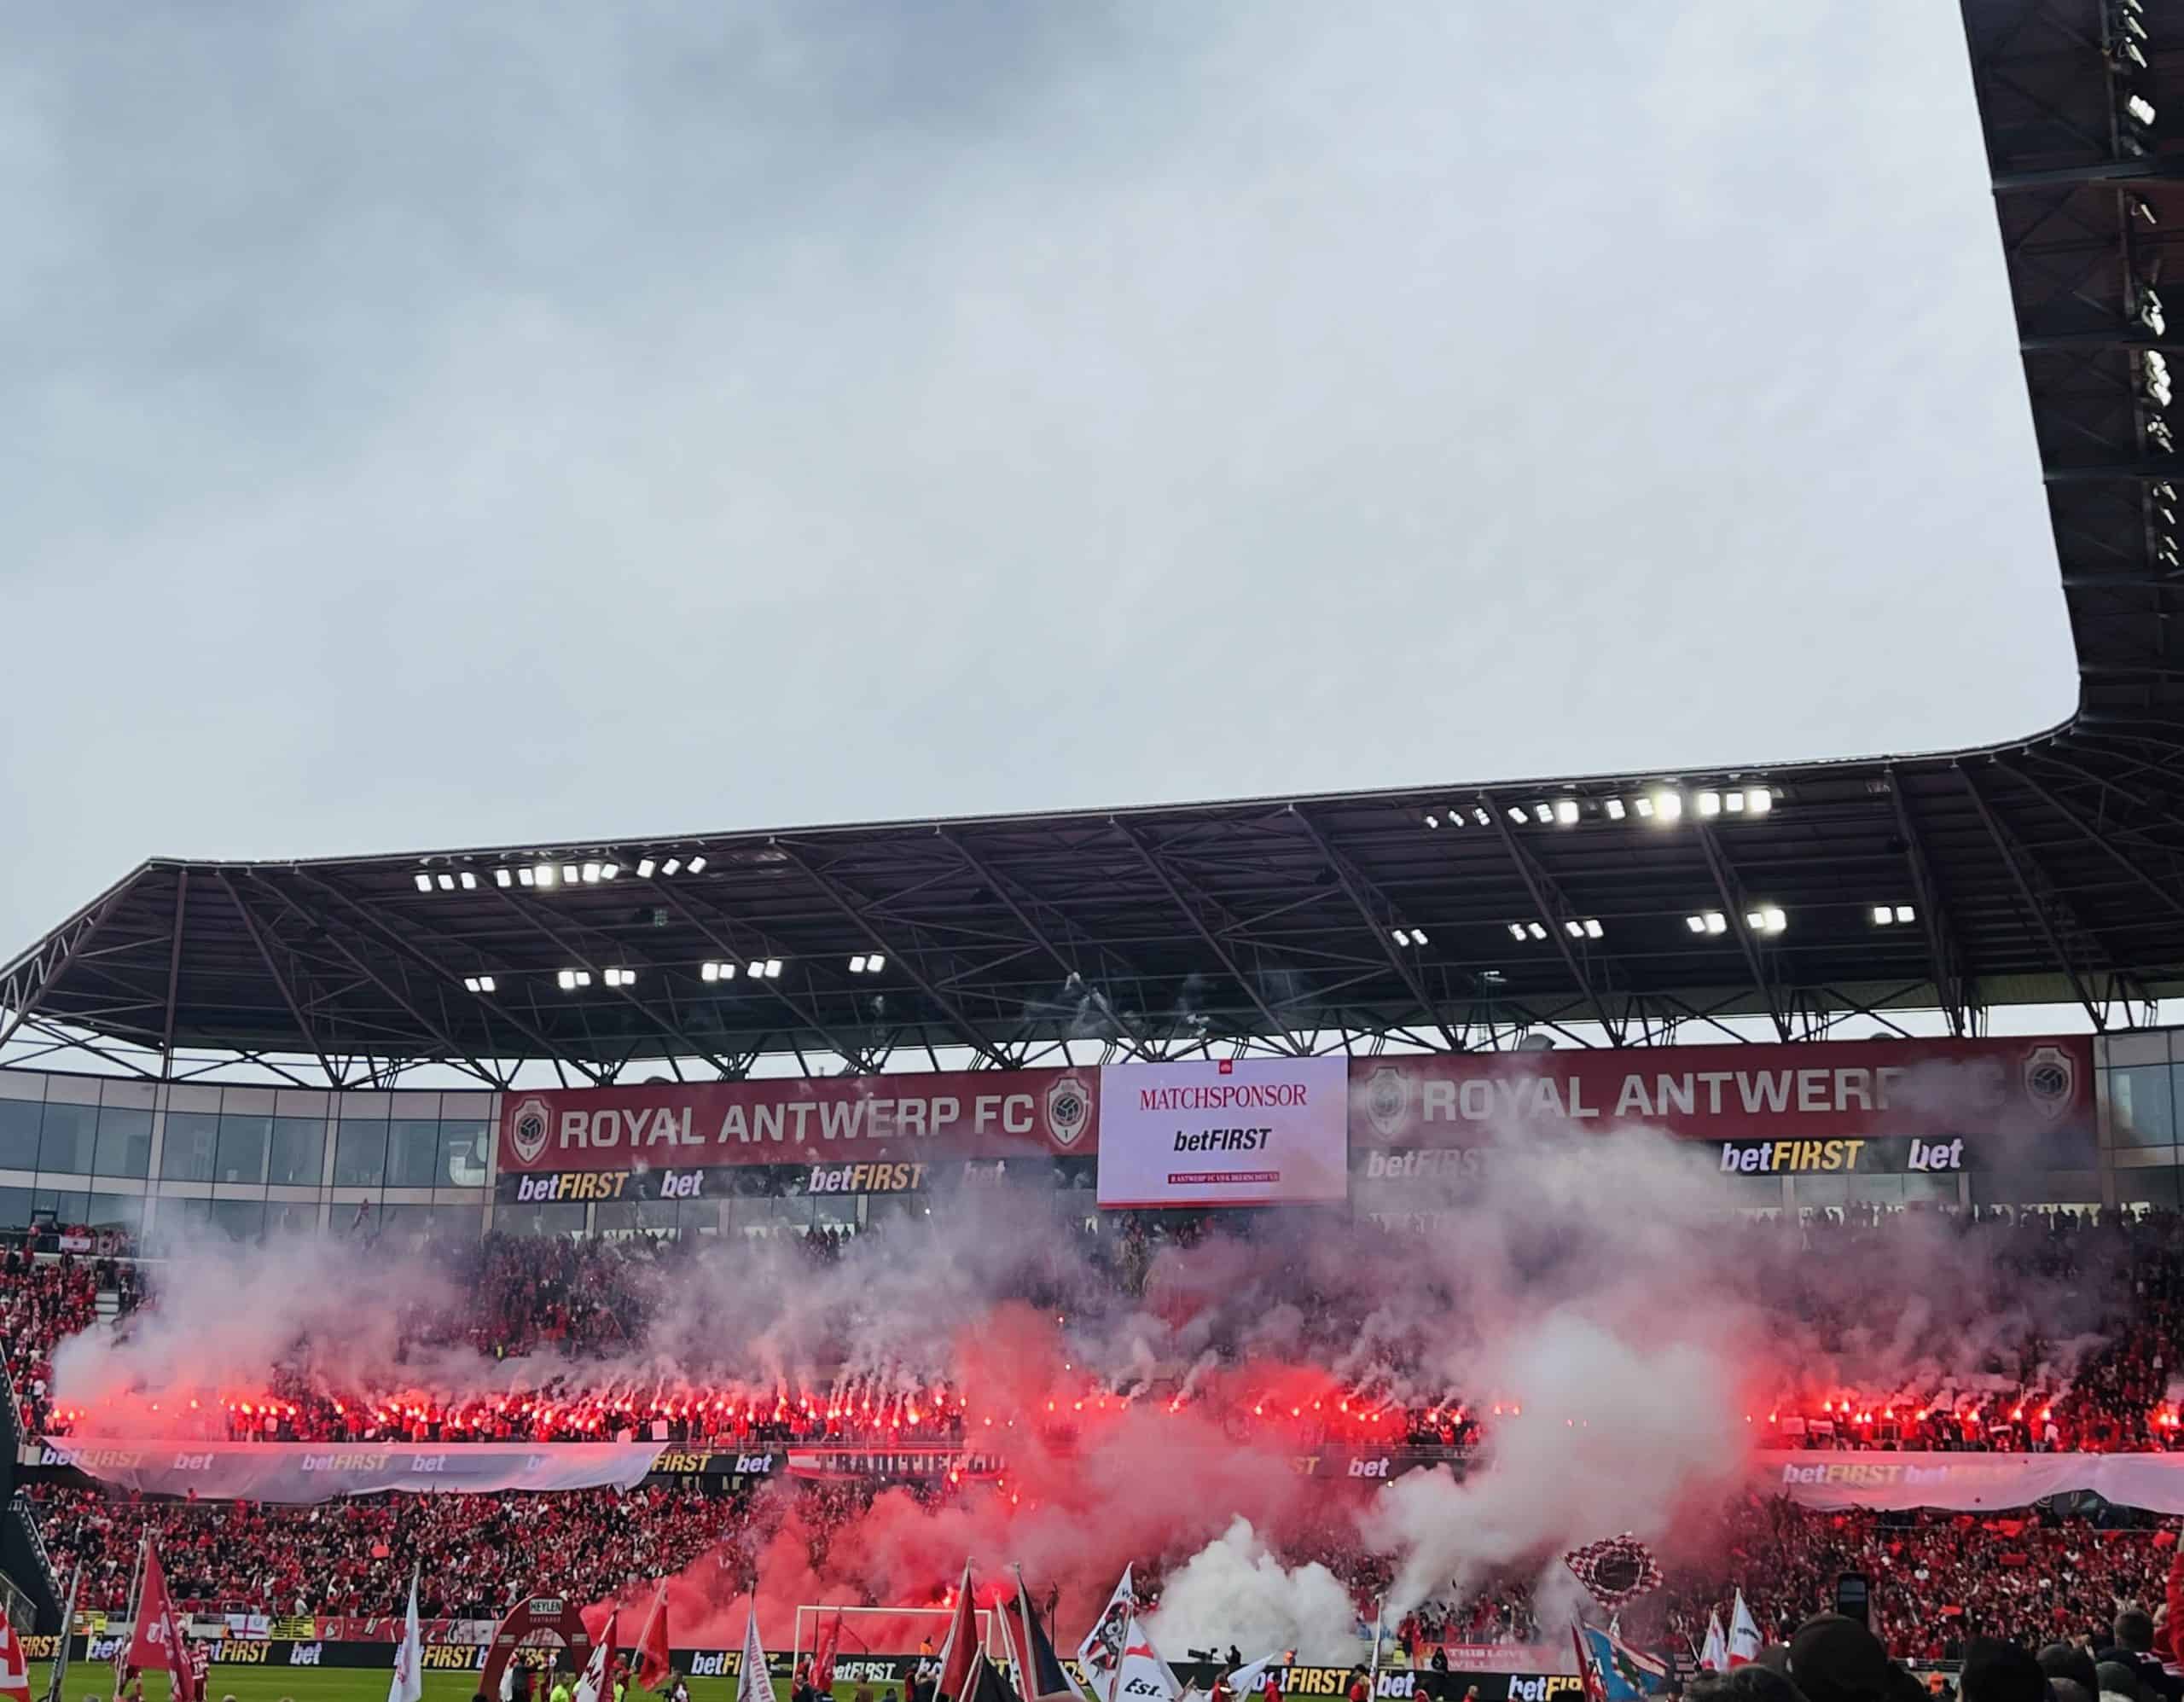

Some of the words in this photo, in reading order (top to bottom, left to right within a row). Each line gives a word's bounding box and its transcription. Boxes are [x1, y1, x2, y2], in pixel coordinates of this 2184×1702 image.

[1140, 1084, 1307, 1111] MATCHSPONSOR
[1423, 1077, 1599, 1122] ROYAL
[560, 1107, 705, 1148] ROYAL
[717, 1097, 960, 1143] ANTWERP
[974, 1094, 1034, 1134] FC
[1174, 1129, 1272, 1152] betFIRST
[1720, 1141, 1865, 1171] betFIRST
[1908, 1139, 1963, 1171] bet
[517, 1172, 629, 1201] betFIRST
[660, 1170, 704, 1198] bet
[809, 1164, 926, 1192] betFIRST
[173, 1453, 213, 1470] bet
[411, 1454, 447, 1473] bet
[651, 1454, 712, 1473] FIRST
[735, 1454, 773, 1473] bet
[1347, 1457, 1391, 1478] bet
[1782, 1463, 1901, 1483] betFIRST
[531, 1601, 561, 1613] HEYLEN
[20, 1635, 62, 1658] FIRST
[290, 1641, 322, 1665] bet
[834, 1661, 897, 1680] etFIRST
[1377, 1670, 1415, 1699] bet
